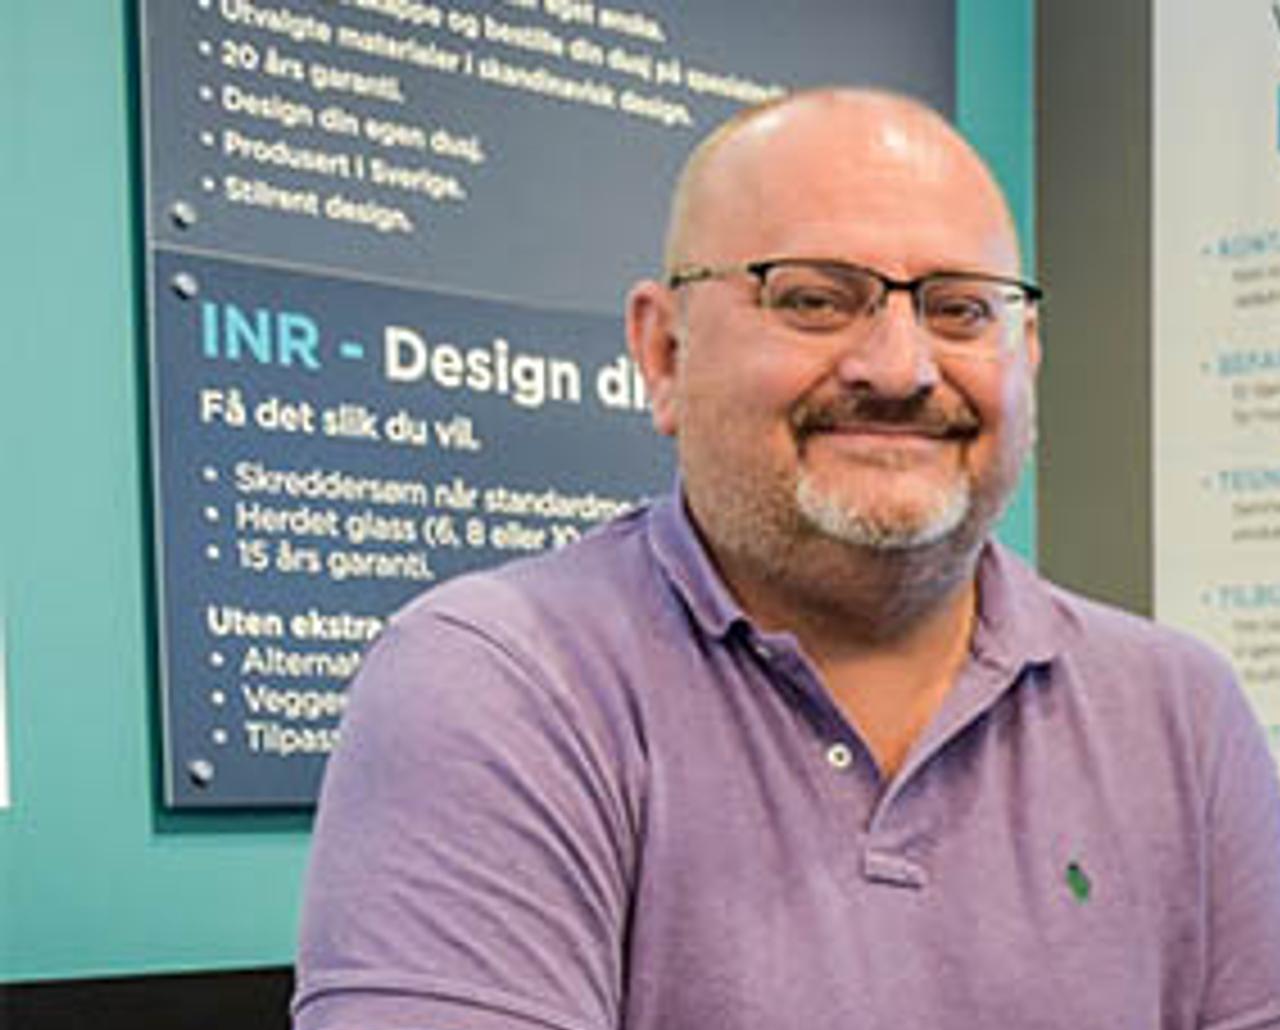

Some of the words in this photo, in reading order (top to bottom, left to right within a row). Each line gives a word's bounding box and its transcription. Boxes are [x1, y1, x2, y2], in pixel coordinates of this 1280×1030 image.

[222, 40, 259, 70] 20
[264, 46, 305, 79] års
[221, 85, 315, 128] Design
[318, 106, 360, 136] din
[223, 130, 351, 179] Produsert
[200, 303, 321, 368] INR
[384, 326, 581, 408] Design
[201, 390, 246, 428] Få
[254, 396, 316, 434] det
[322, 406, 380, 441] slik
[385, 413, 428, 446] du
[235, 461, 427, 509] Skreddersøm
[434, 478, 477, 510] når
[236, 505, 340, 541] Herdet
[346, 517, 416, 550] glass
[467, 524, 485, 547] 8
[490, 521, 546, 550] eller
[237, 543, 271, 570] 15
[276, 544, 322, 573] års
[208, 604, 285, 638] Uten
